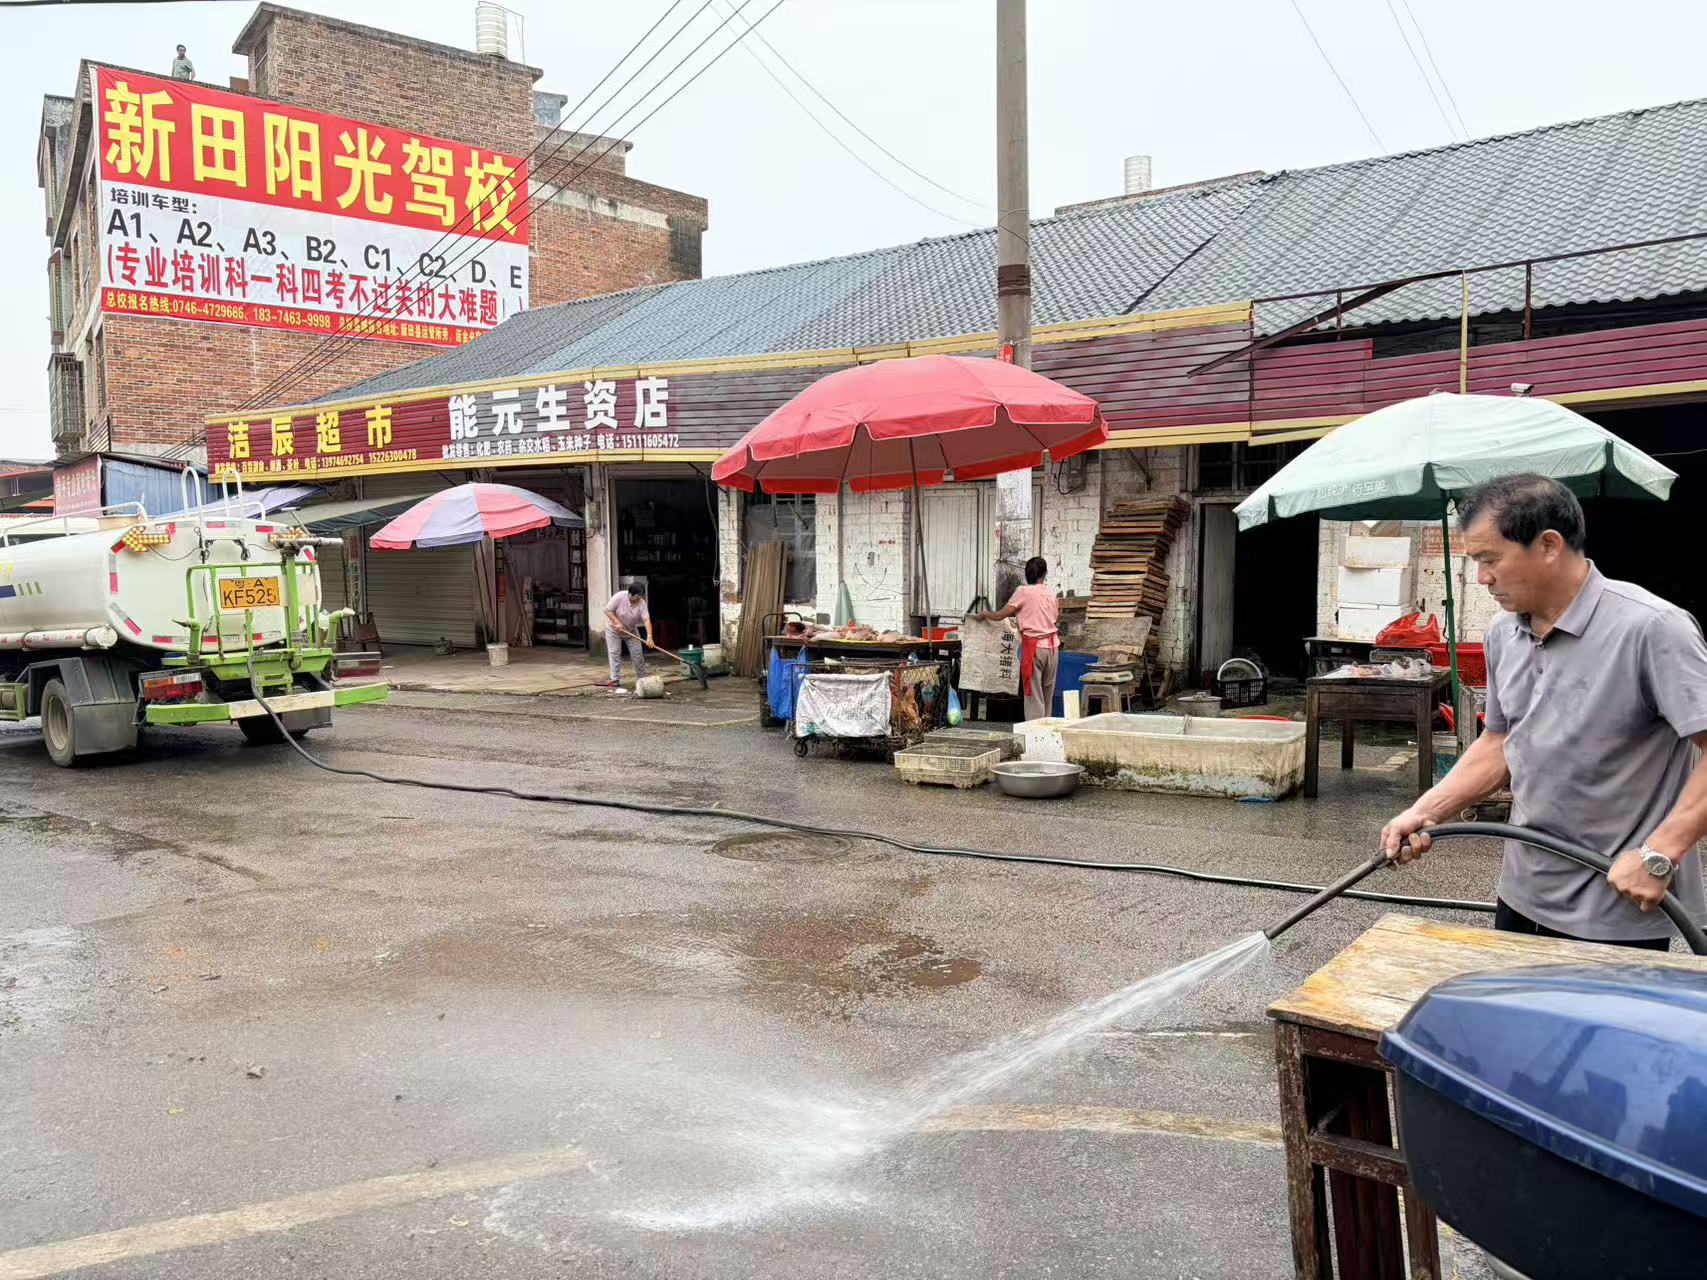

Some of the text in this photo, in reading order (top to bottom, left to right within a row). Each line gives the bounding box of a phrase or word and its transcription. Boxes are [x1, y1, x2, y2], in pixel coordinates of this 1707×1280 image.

[104, 81, 517, 236] 新田阳光驾校
[110, 187, 200, 215] 培训车型：
[228, 404, 395, 459] 洁辰超市
[449, 376, 669, 441] 能元生资店
[223, 588, 277, 606] KF525
[999, 630, 1014, 680] 海大猪料
